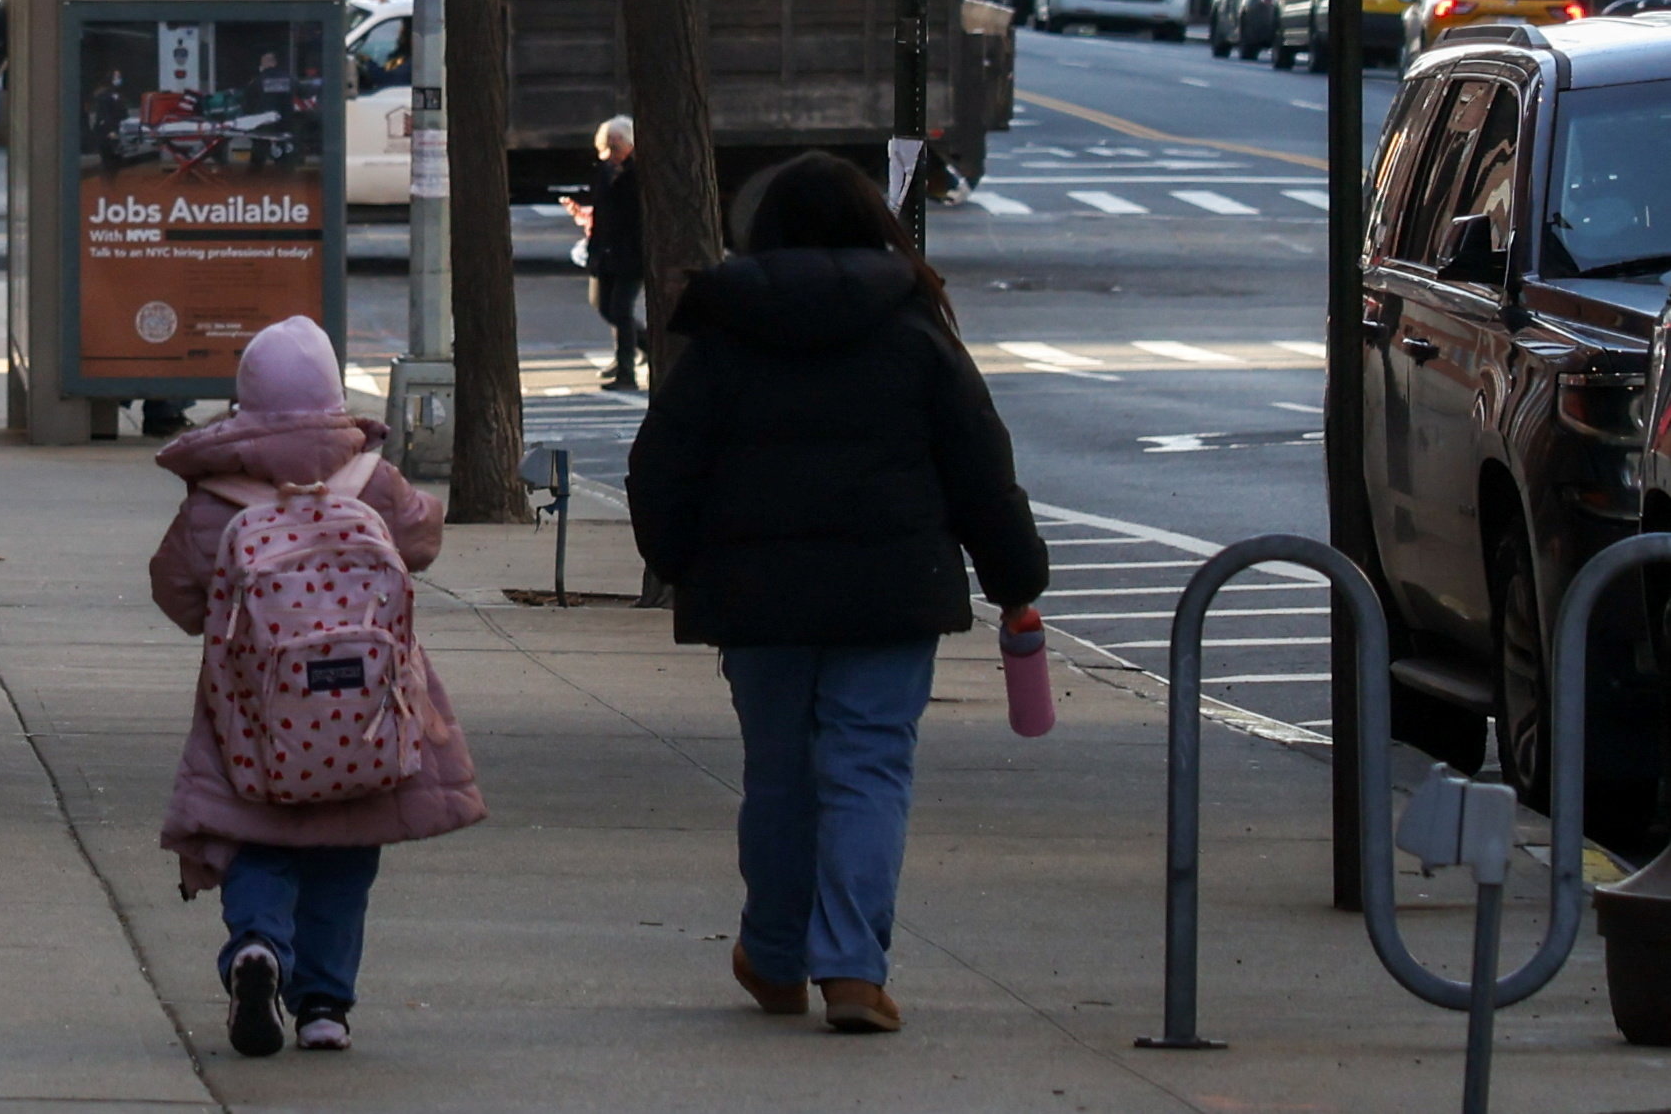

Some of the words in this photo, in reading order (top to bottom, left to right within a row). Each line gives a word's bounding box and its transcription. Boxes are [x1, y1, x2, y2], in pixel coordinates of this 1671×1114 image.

[90, 196, 162, 223] Jobs
[168, 196, 309, 223] Available
[90, 230, 123, 242] With
[126, 230, 161, 242] NYC
[90, 247, 111, 258] Talk
[115, 248, 127, 258] to
[129, 249, 142, 258] an
[145, 247, 170, 258] NYC
[173, 246, 205, 261] hiring
[207, 246, 275, 261] professional
[277, 246, 314, 261] today!
